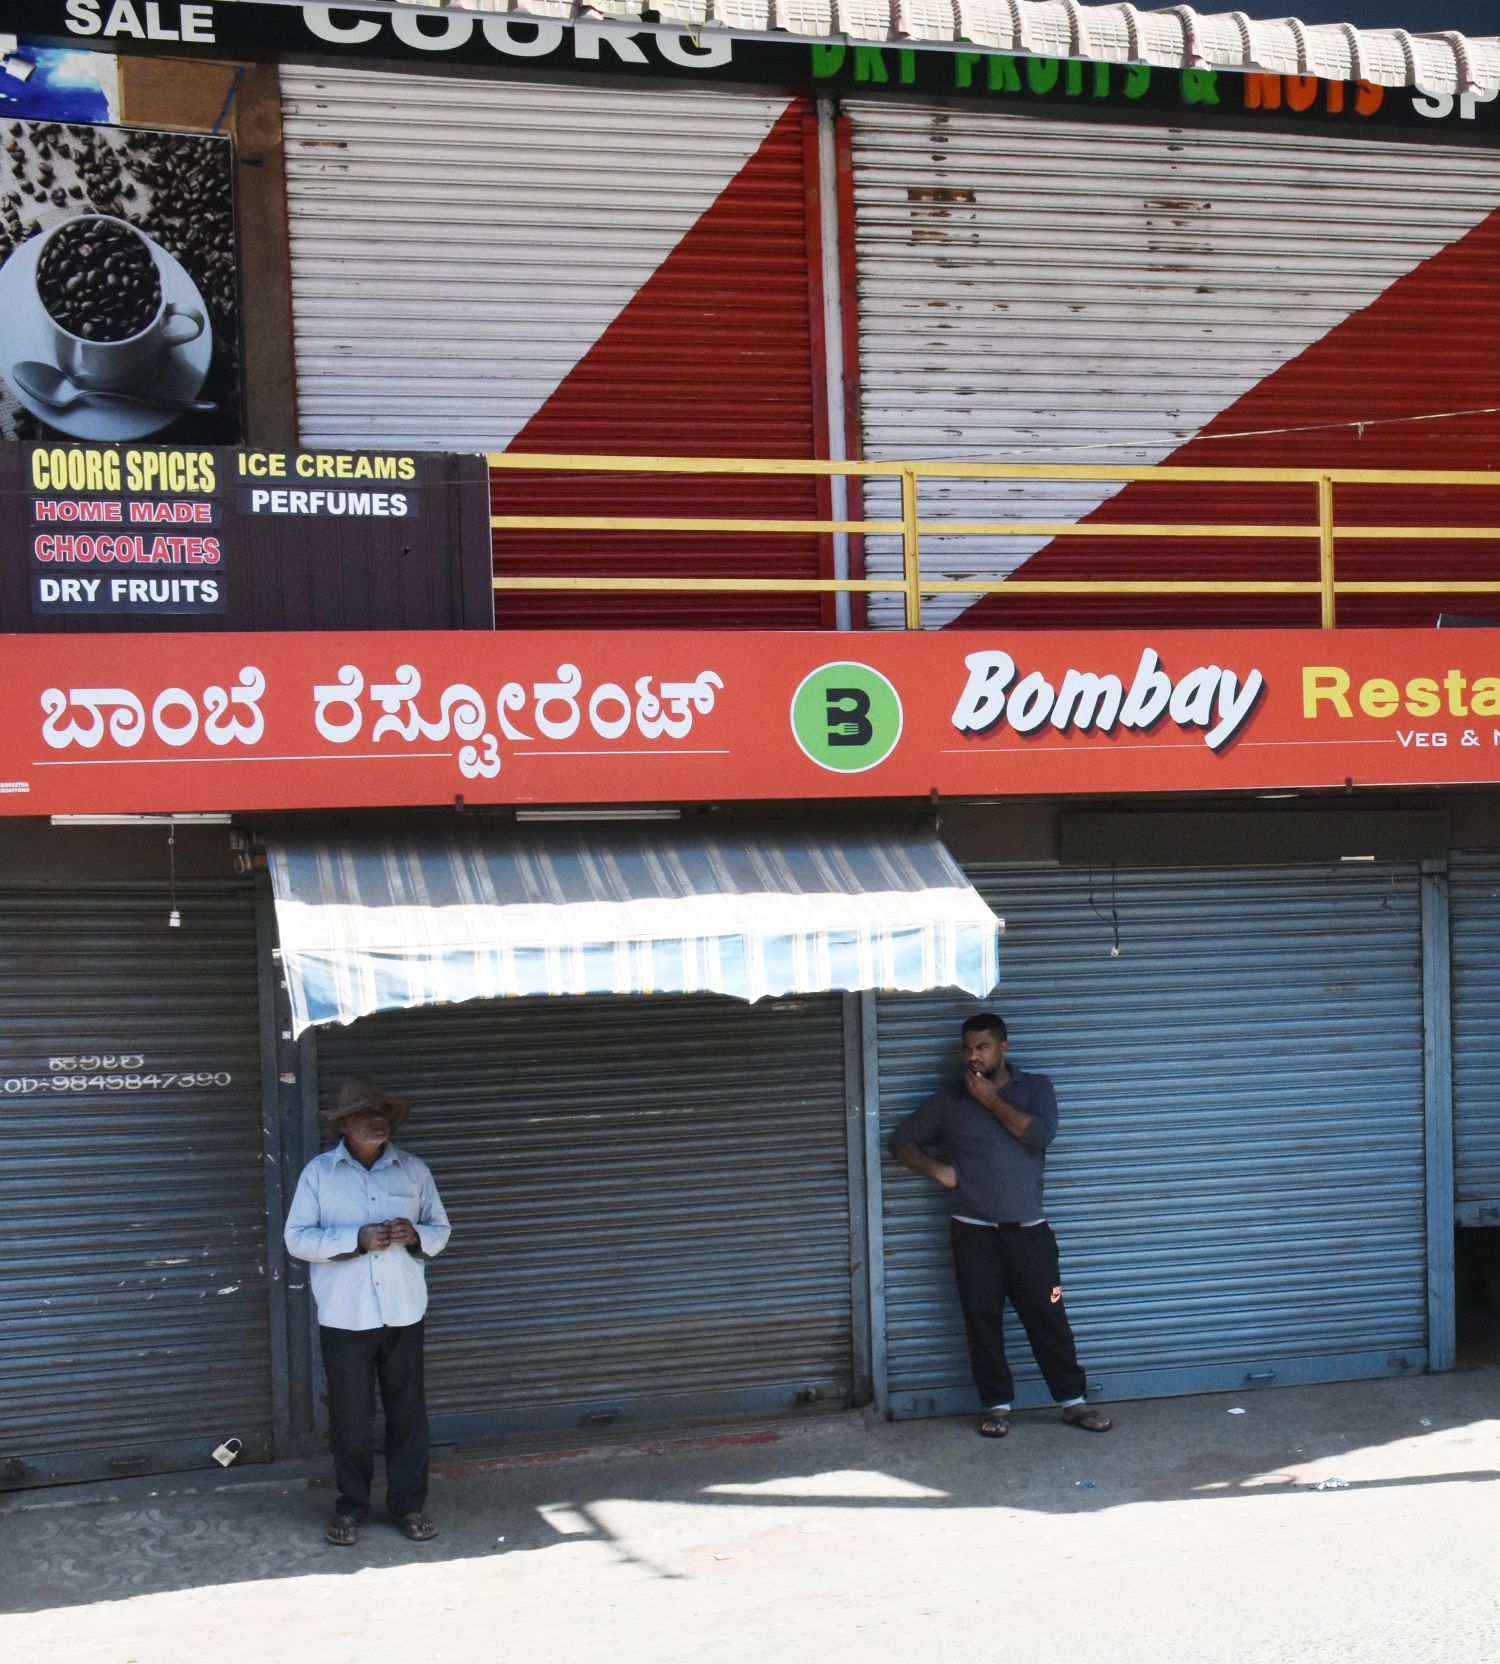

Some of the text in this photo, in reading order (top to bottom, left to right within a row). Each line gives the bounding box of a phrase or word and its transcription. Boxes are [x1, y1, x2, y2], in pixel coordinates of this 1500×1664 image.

[65, 0, 217, 44] SALE
[300, 5, 733, 68] COORG
[32, 448, 216, 494] COORG SPICES
[238, 453, 416, 481] ICE CREAMS
[35, 501, 212, 523] HOME MADE
[252, 489, 408, 517] PERFUMES
[34, 534, 222, 565] CHOCOLATES
[40, 579, 219, 603] DRY FRUITS
[39, 664, 267, 748] ಬಾಂಬೆ
[950, 646, 1264, 752] Bombay
[1460, 729, 1481, 747] &
